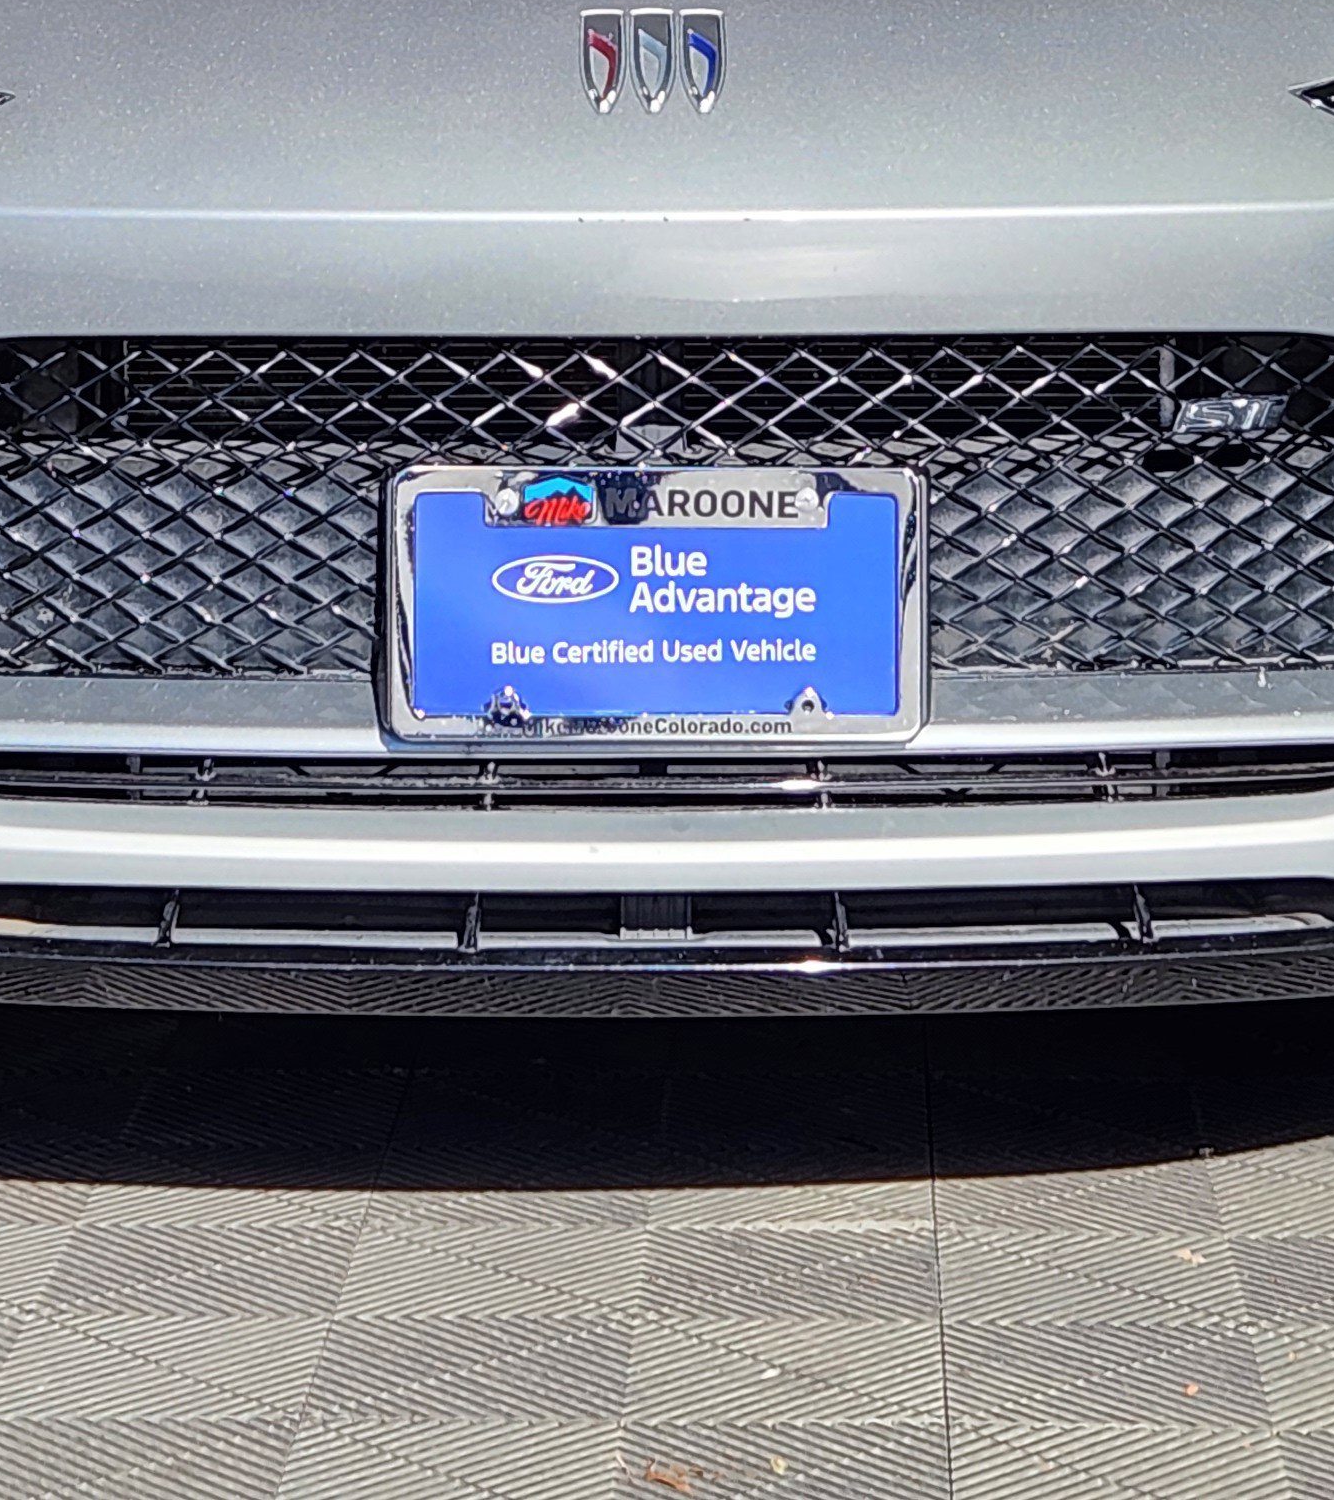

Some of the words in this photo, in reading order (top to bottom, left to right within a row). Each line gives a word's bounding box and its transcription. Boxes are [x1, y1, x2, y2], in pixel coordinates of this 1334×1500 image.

[1173, 396, 1287, 433] ST
[605, 488, 800, 519] MAROONE
[630, 544, 707, 577] Blue
[516, 561, 595, 596] Ford
[629, 581, 817, 619] Advantage
[491, 641, 545, 664] Blue
[552, 639, 654, 664] Certified
[662, 639, 723, 662] Used
[731, 638, 817, 662] Vehicle
